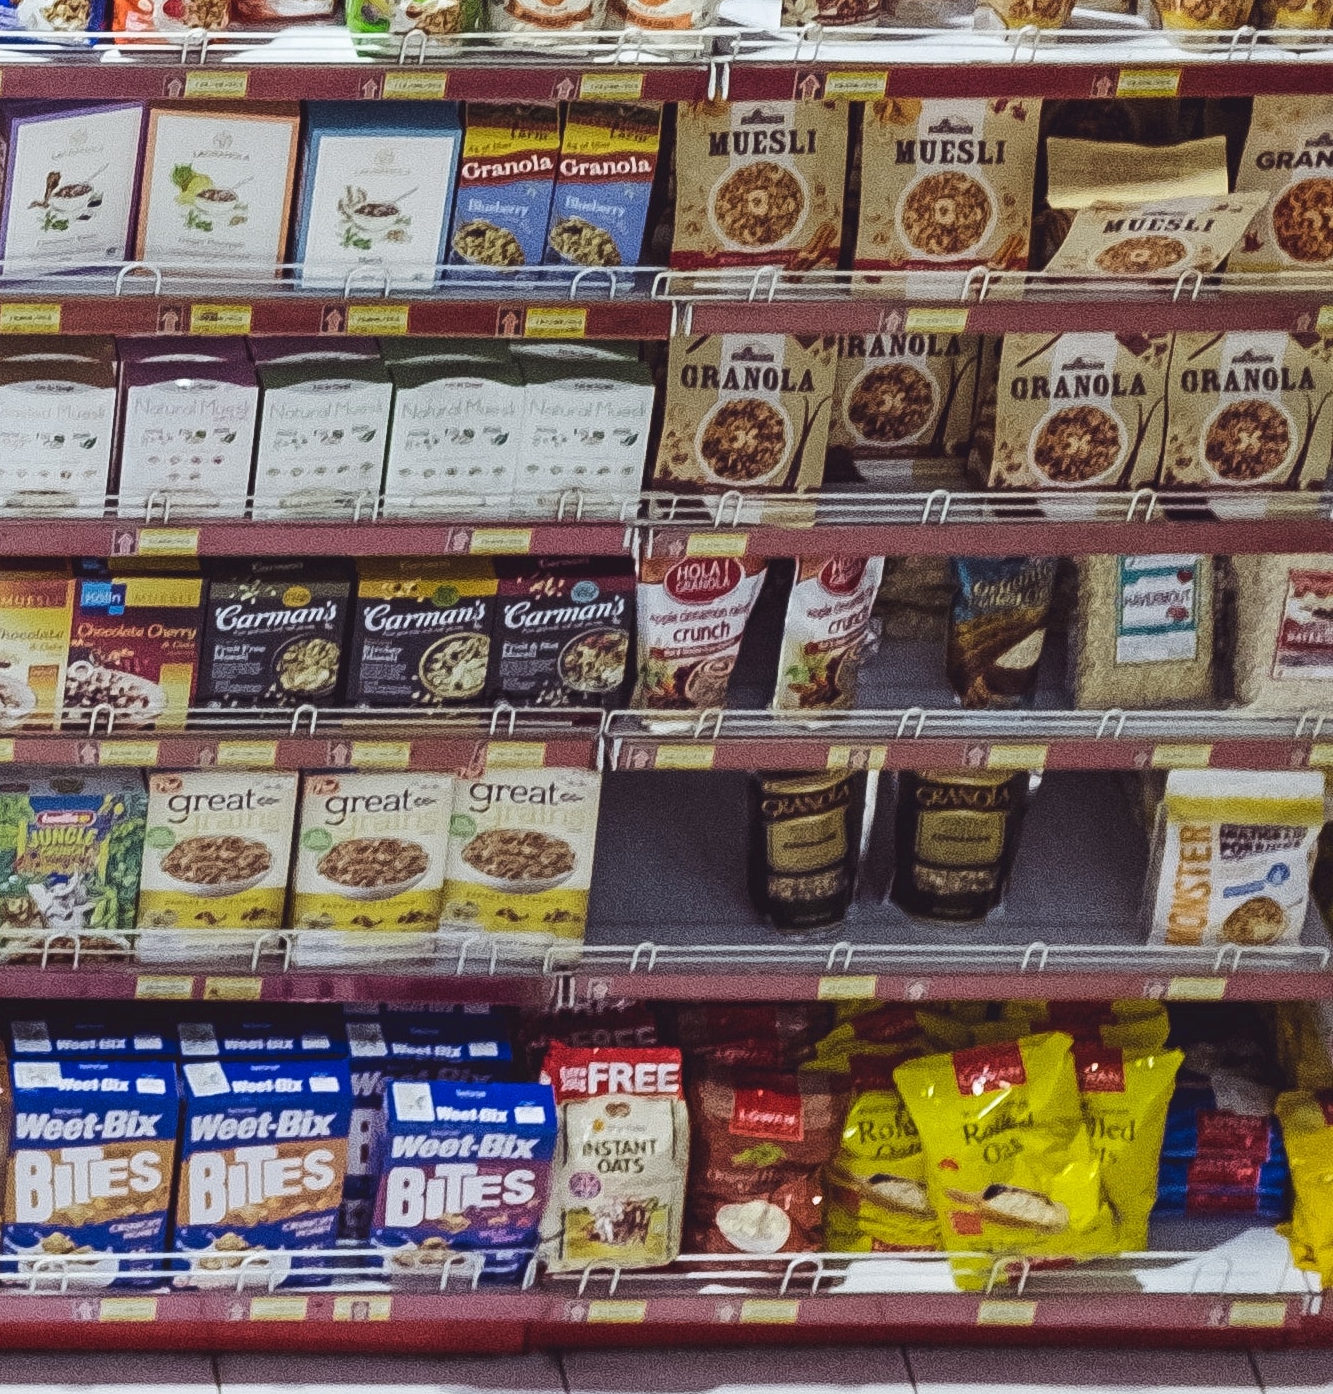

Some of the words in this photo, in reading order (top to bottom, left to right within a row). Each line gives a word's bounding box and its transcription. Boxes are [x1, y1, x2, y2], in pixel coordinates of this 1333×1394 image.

[708, 130, 817, 156] MUESLI
[895, 140, 1006, 165] MUESLI
[462, 155, 554, 180] Granola
[560, 156, 652, 178] Granola
[1256, 151, 1333, 171] GRAN
[468, 198, 529, 217] Blueberry
[565, 196, 626, 217] Blueberry
[1103, 216, 1216, 234] MUESLI
[681, 365, 815, 392] GRANOLA
[1011, 372, 1146, 399] GRANOLA
[1180, 368, 1316, 394] GRANOLA
[214, 599, 337, 632] Carman's
[363, 599, 485, 632] Carman's
[503, 596, 625, 629] Carman's
[77, 622, 143, 639] Chocolate
[144, 625, 197, 640] Cherry
[673, 621, 731, 644] crunch
[167, 788, 256, 825] great
[325, 788, 414, 825] great
[470, 780, 560, 812] great
[916, 782, 1012, 806] GRANOLA
[588, 1061, 681, 1096] FREE
[16, 1109, 164, 1142] Weet-Bix
[191, 1108, 337, 1142] Weet-Bix
[391, 1133, 540, 1160] Weet-Bix
[582, 1137, 657, 1159] INSTANT
[598, 1157, 644, 1176] OATS
